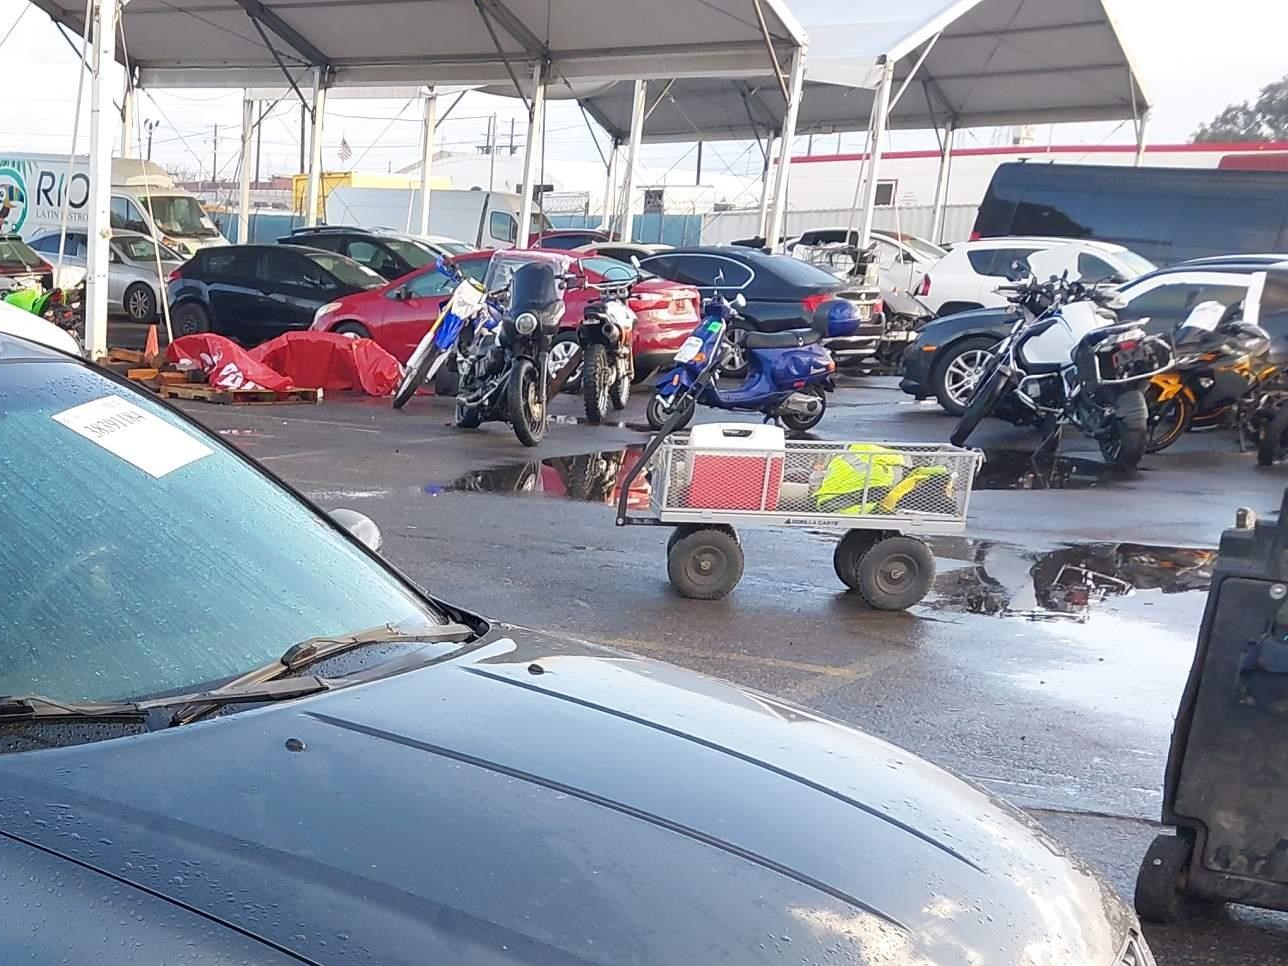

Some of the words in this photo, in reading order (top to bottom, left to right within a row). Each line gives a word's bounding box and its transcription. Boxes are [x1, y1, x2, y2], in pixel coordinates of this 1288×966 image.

[36, 170, 90, 209] RIO
[36, 209, 59, 220] LATIN
[83, 408, 148, 439] 38391184
